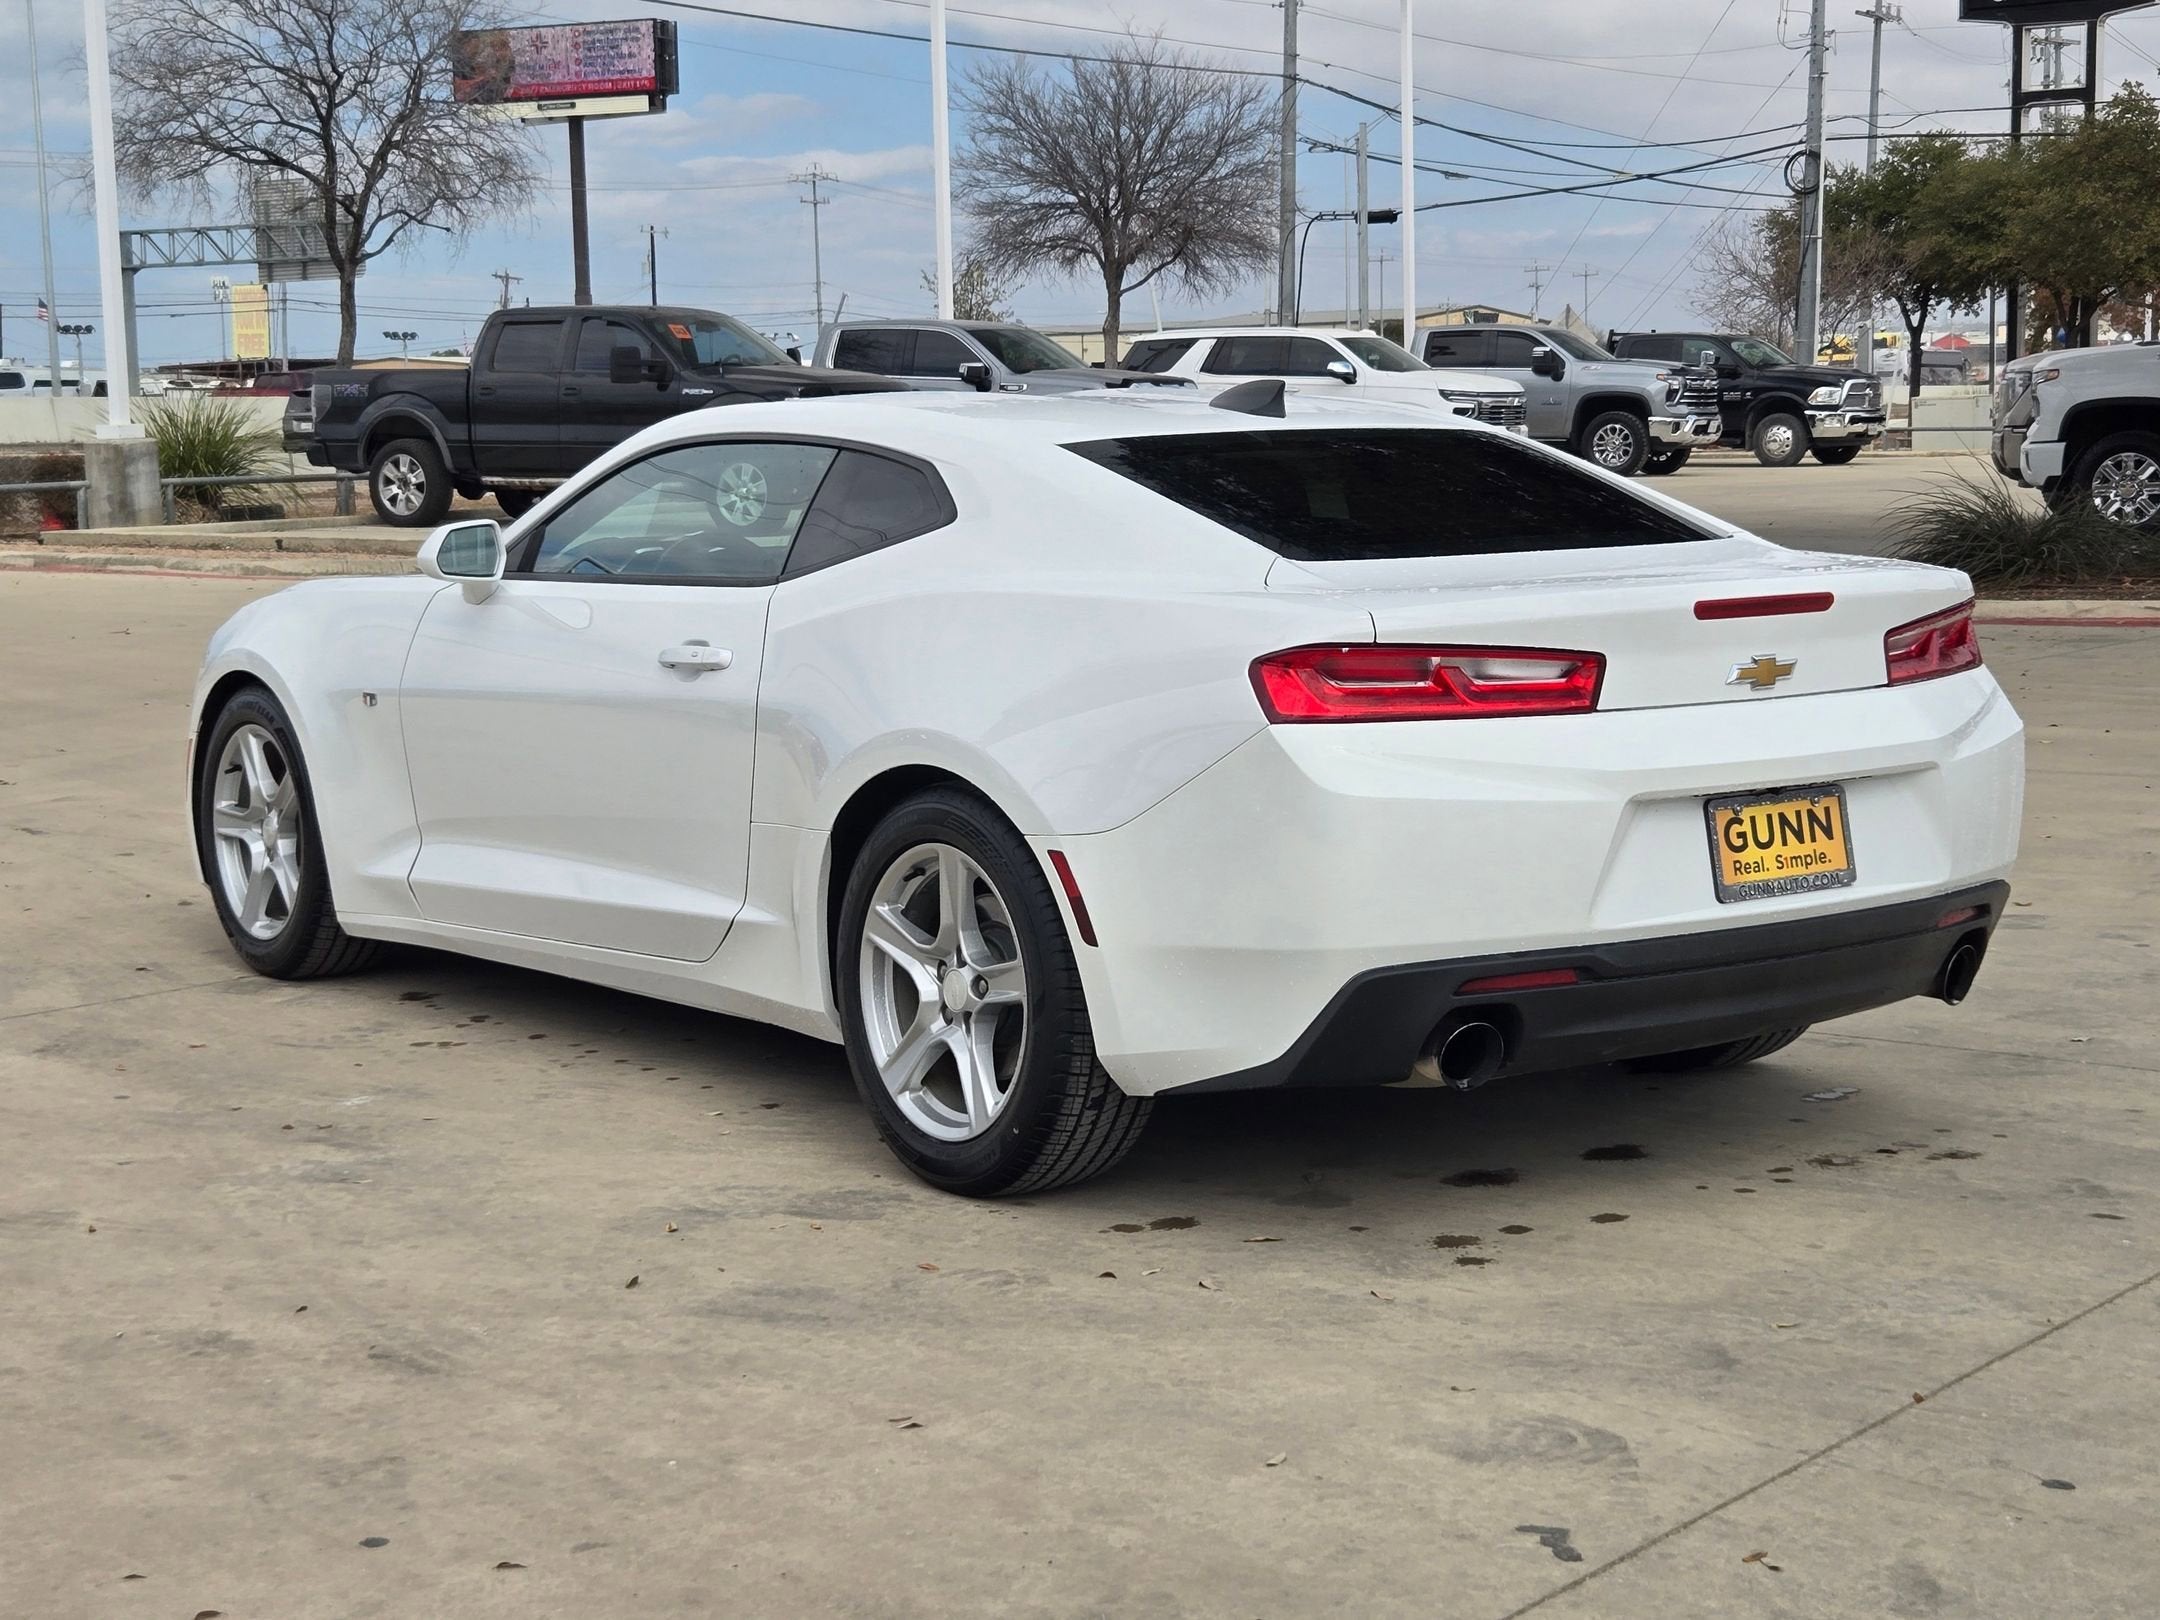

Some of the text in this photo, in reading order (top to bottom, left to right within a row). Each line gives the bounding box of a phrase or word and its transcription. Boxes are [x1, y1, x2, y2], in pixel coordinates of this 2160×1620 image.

[1723, 806, 1834, 854] GUNN
[1733, 856, 1770, 876] Real.
[1739, 872, 1841, 898] GUNNAUTO.COM
